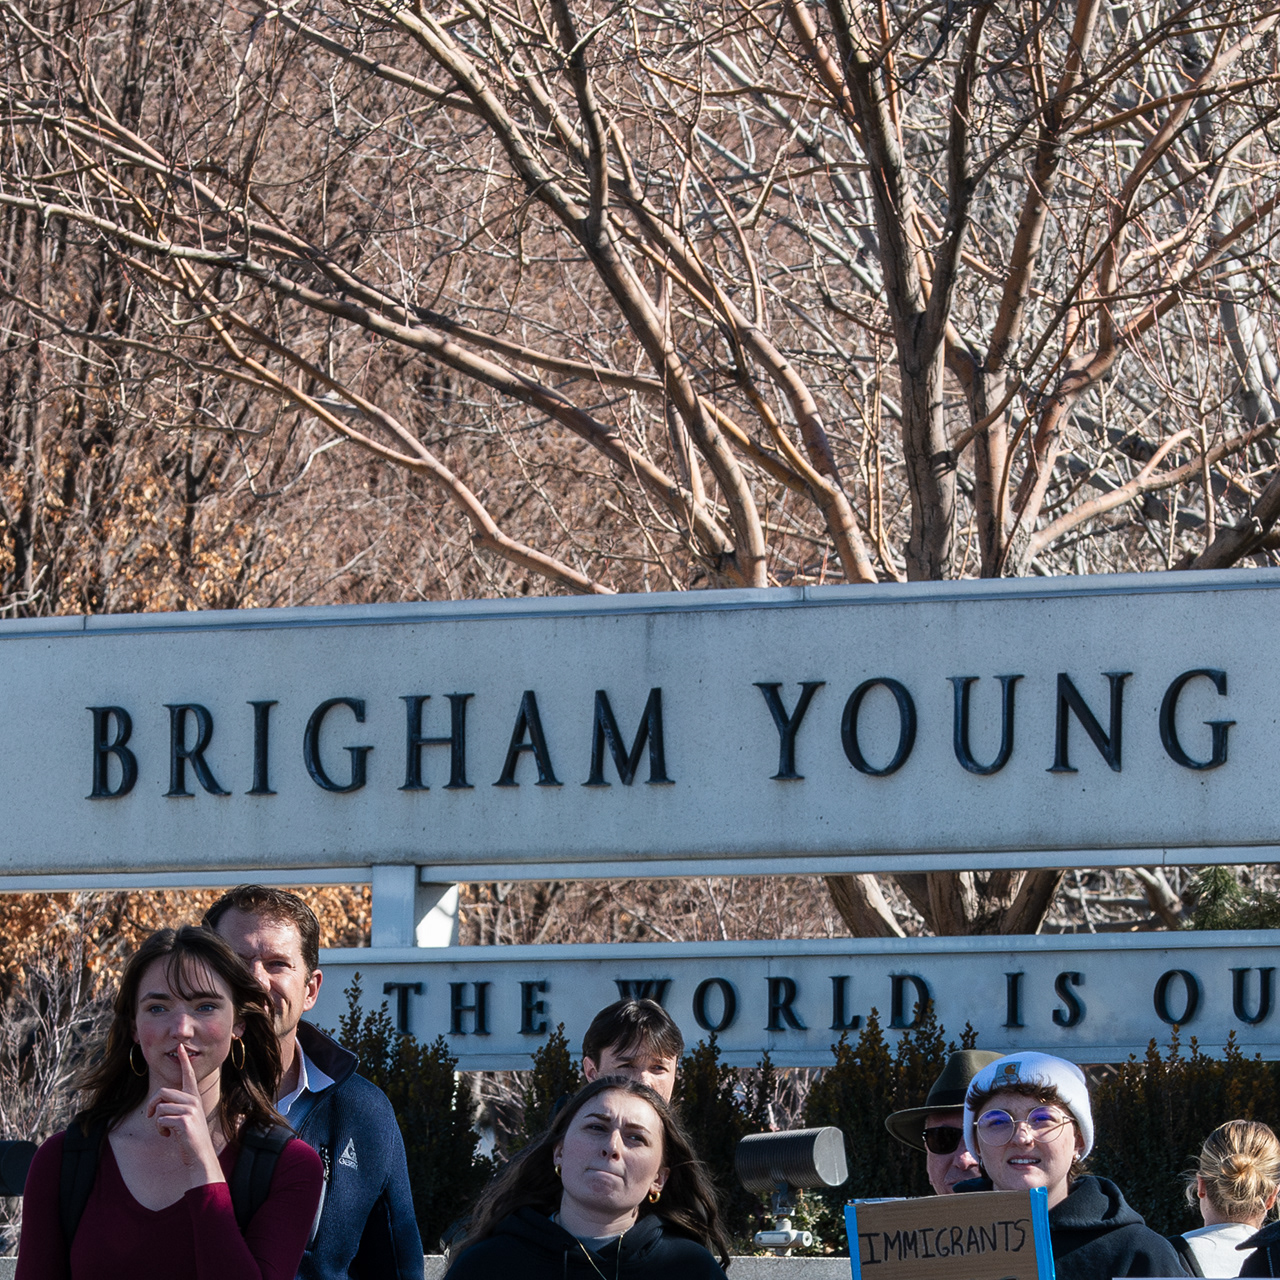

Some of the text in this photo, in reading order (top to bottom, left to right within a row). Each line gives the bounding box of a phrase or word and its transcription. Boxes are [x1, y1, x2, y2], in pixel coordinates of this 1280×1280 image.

[86, 687, 676, 800] BRIGHAM
[753, 668, 1236, 782] YOUNG
[382, 980, 554, 1036] THE
[1002, 971, 1085, 1030] IS
[859, 1219, 1030, 1265] IMMIGRANTS
